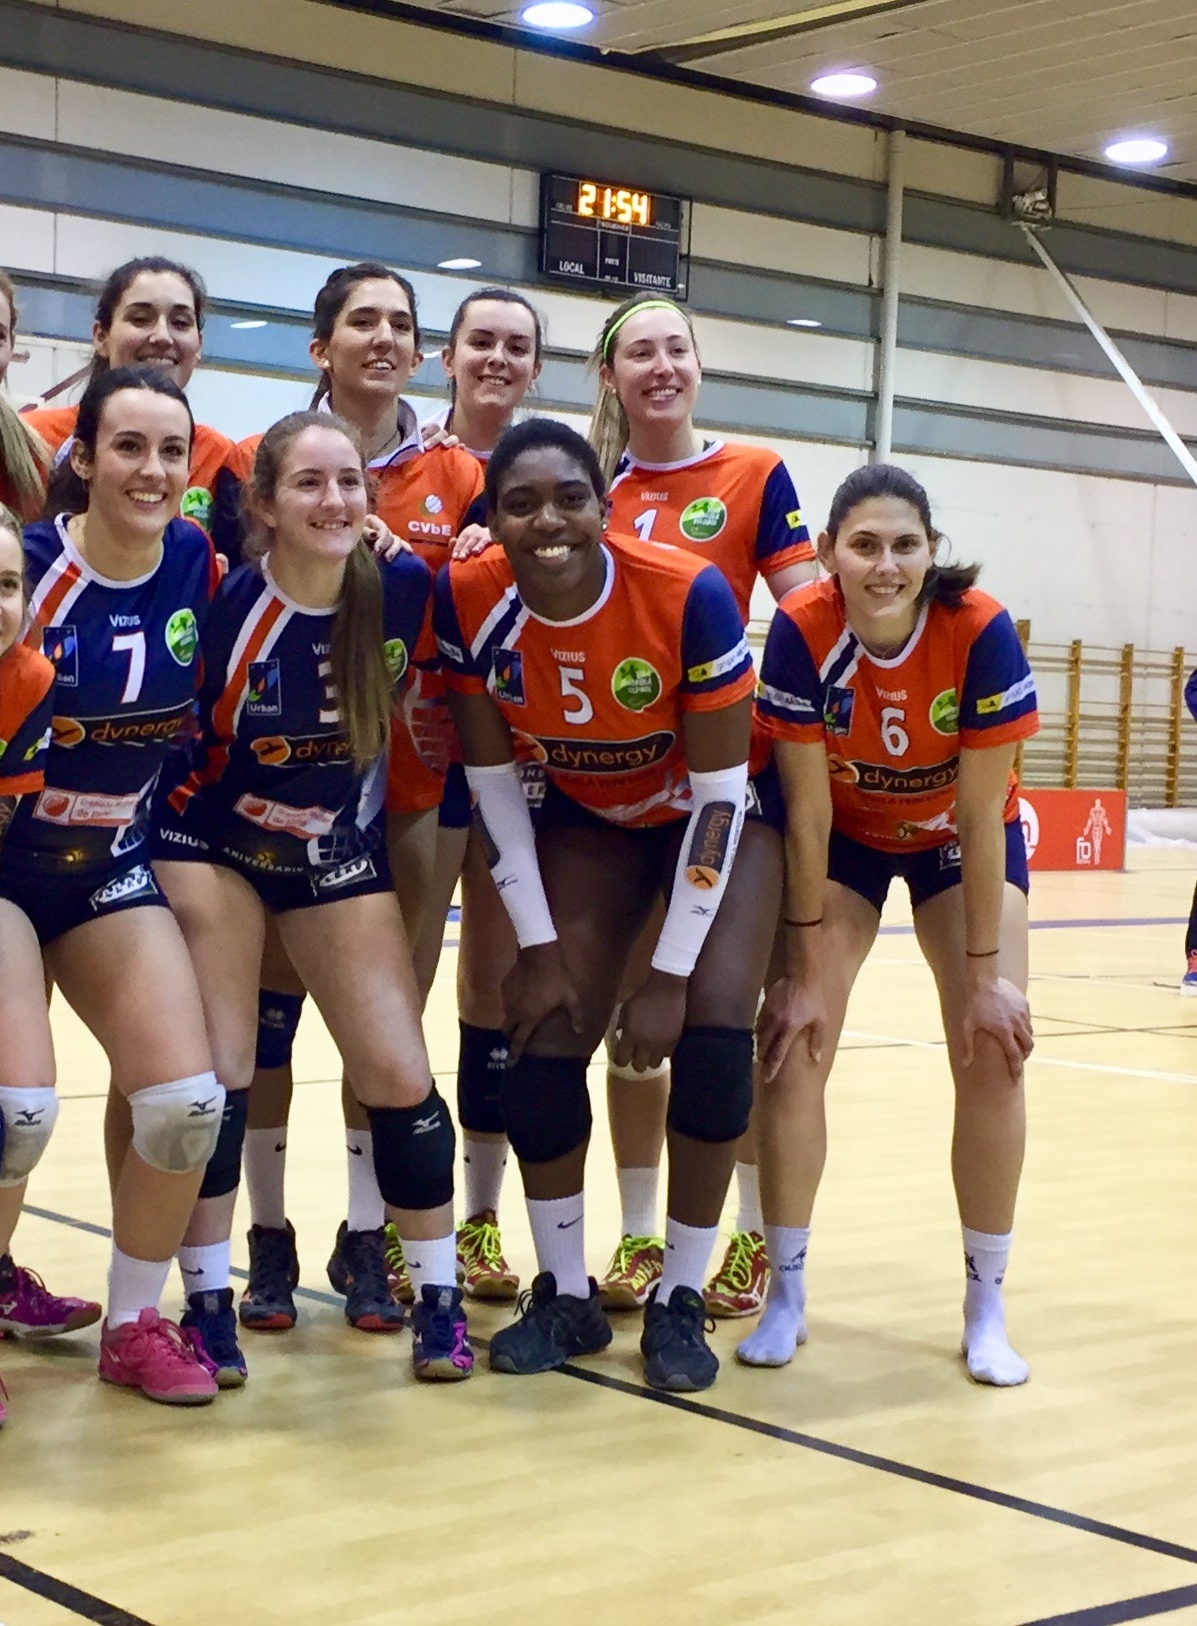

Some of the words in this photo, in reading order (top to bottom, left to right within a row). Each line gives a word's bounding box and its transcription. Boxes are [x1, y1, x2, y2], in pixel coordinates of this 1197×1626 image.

[578, 183, 649, 225] 21:54
[559, 260, 585, 275] LOCAL
[633, 272, 672, 288] VISITANTE
[407, 519, 452, 537] CVbE
[112, 631, 146, 705] 7
[249, 703, 279, 713] Urban
[558, 665, 594, 725] 5
[880, 707, 910, 757] 6
[551, 743, 657, 767] dynergy
[700, 808, 732, 866] dynergy
